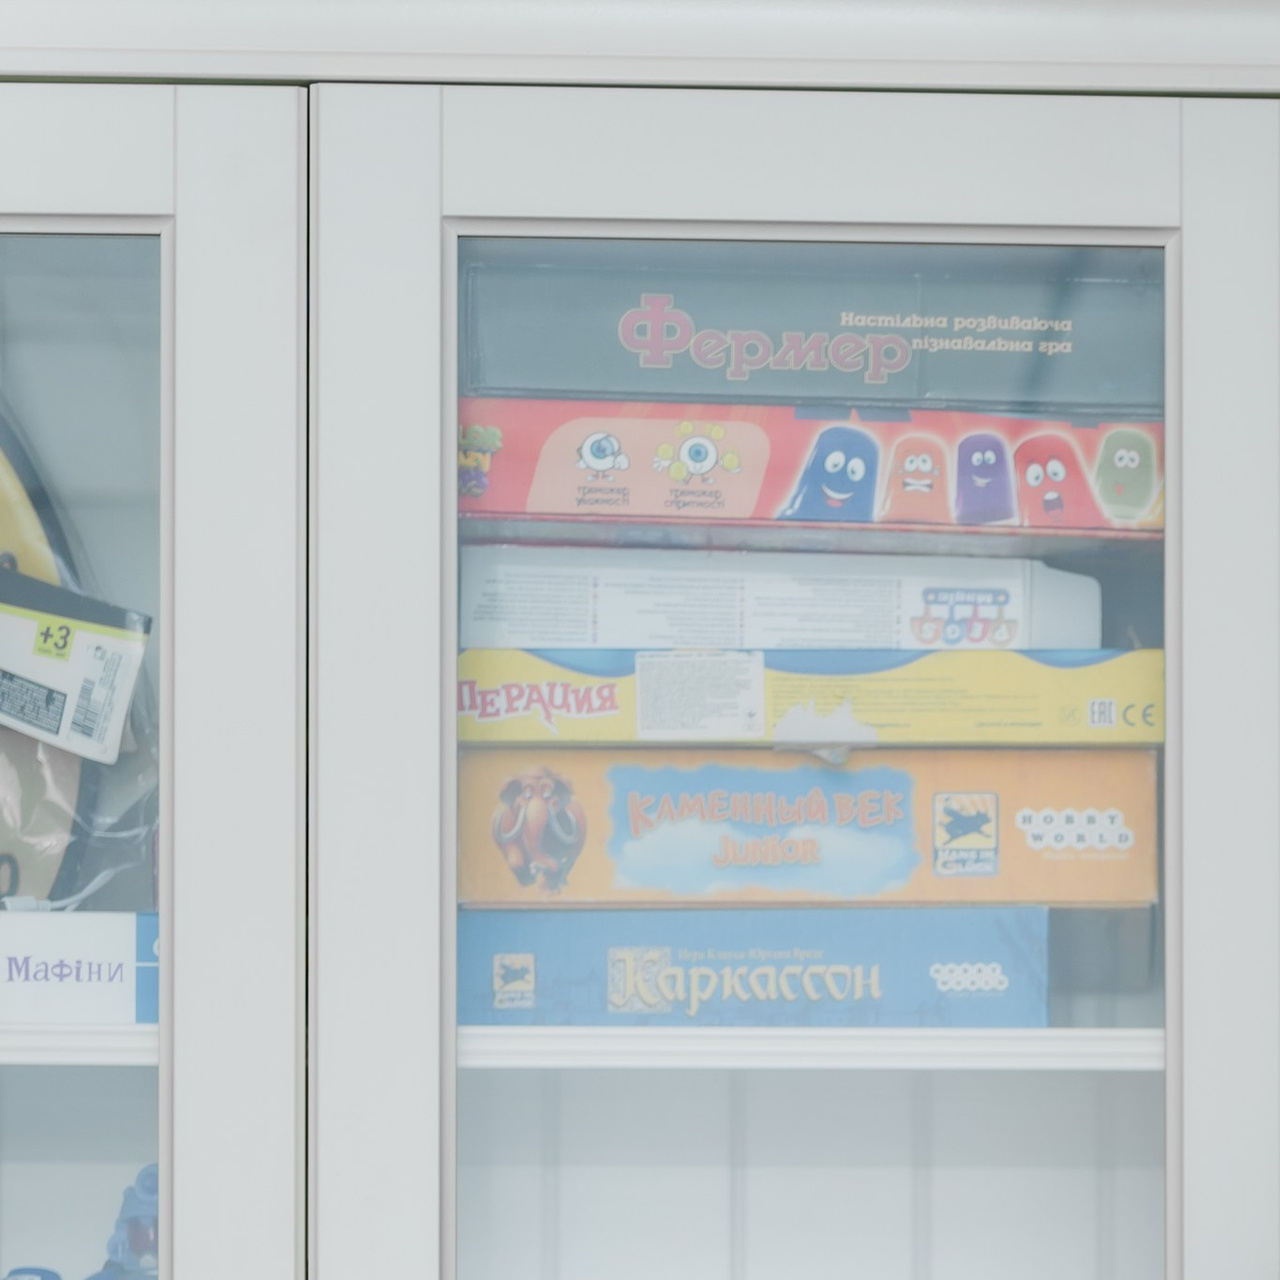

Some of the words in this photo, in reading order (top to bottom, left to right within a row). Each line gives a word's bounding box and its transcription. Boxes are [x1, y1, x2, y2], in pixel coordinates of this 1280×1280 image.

[840, 311, 947, 330] Настільна
[953, 315, 1073, 333] розвиваюча
[617, 293, 913, 384] Фермер
[911, 336, 1032, 354] пізнавальна
[1038, 338, 1073, 355] гра
[40, 624, 72, 651] +3
[627, 787, 828, 838] КАМЕННЫЙ
[832, 790, 905, 827] ВЕК
[1020, 813, 1119, 827] HOBBY
[1030, 832, 1131, 845] WORLD
[608, 947, 882, 1016] Каркассон
